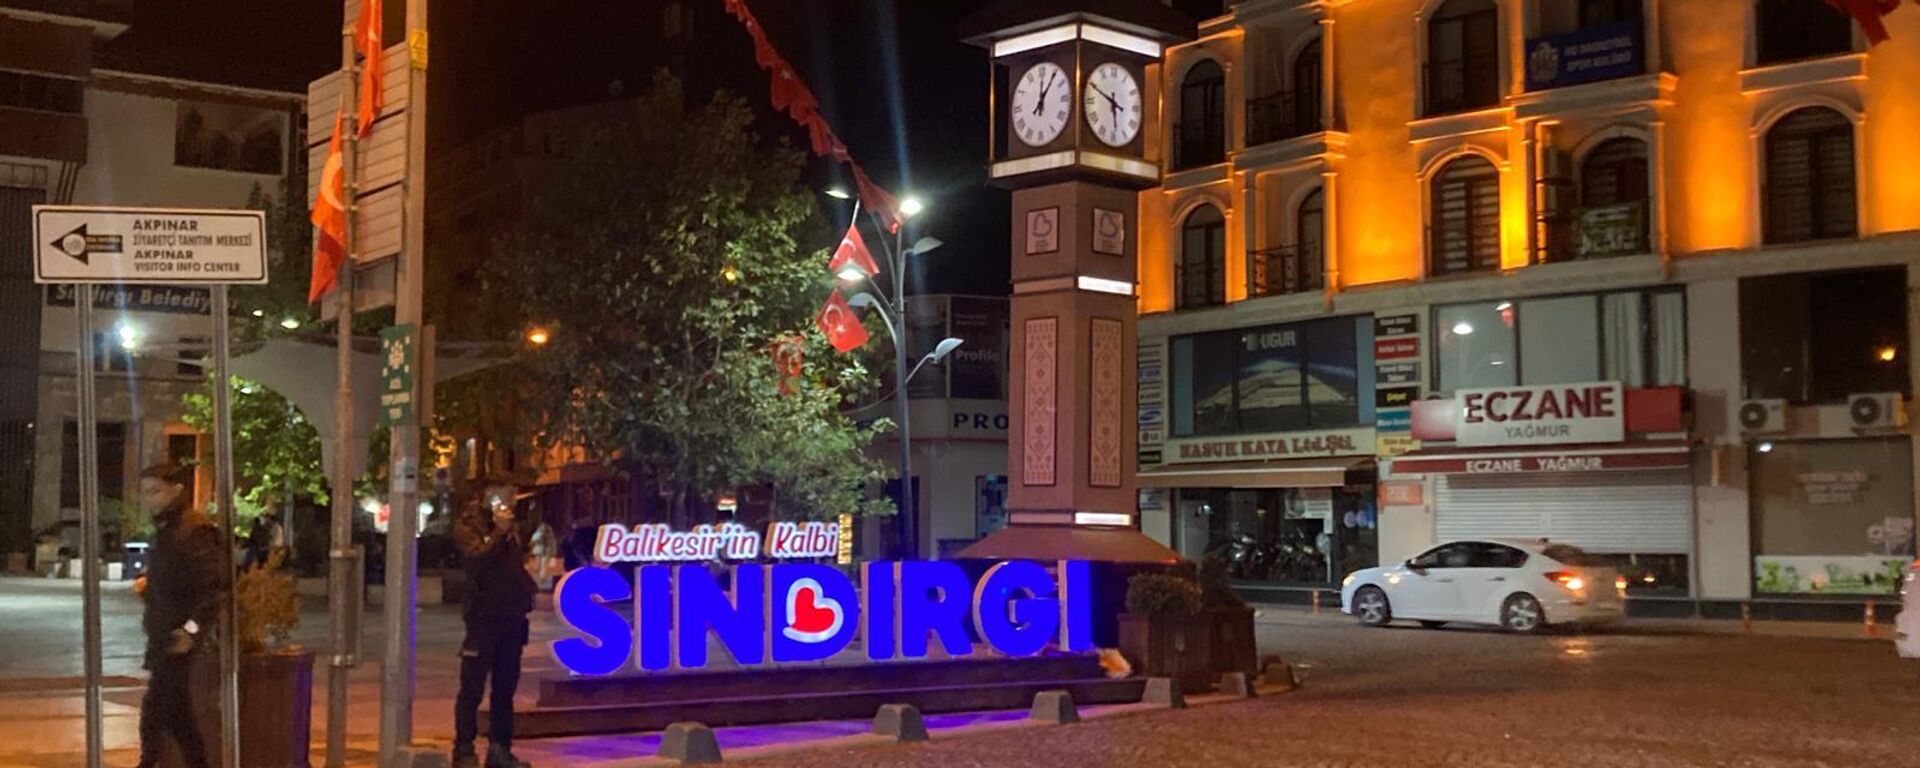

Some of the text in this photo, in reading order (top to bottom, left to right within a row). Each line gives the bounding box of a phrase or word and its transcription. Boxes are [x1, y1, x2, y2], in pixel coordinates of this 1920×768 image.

[132, 219, 198, 231] AKPINAR
[134, 250, 194, 259] AKPINAR
[134, 261, 240, 273] VISITOR INFO CENTER
[1464, 386, 1615, 423] ECZANE
[1504, 424, 1571, 439] YAĞMUR
[1241, 438, 1289, 456] KAYA
[1466, 456, 1602, 473] ECZANE YAĞMUR
[772, 522, 840, 558] Kalbi
[551, 560, 1093, 676] SINDIRGI
